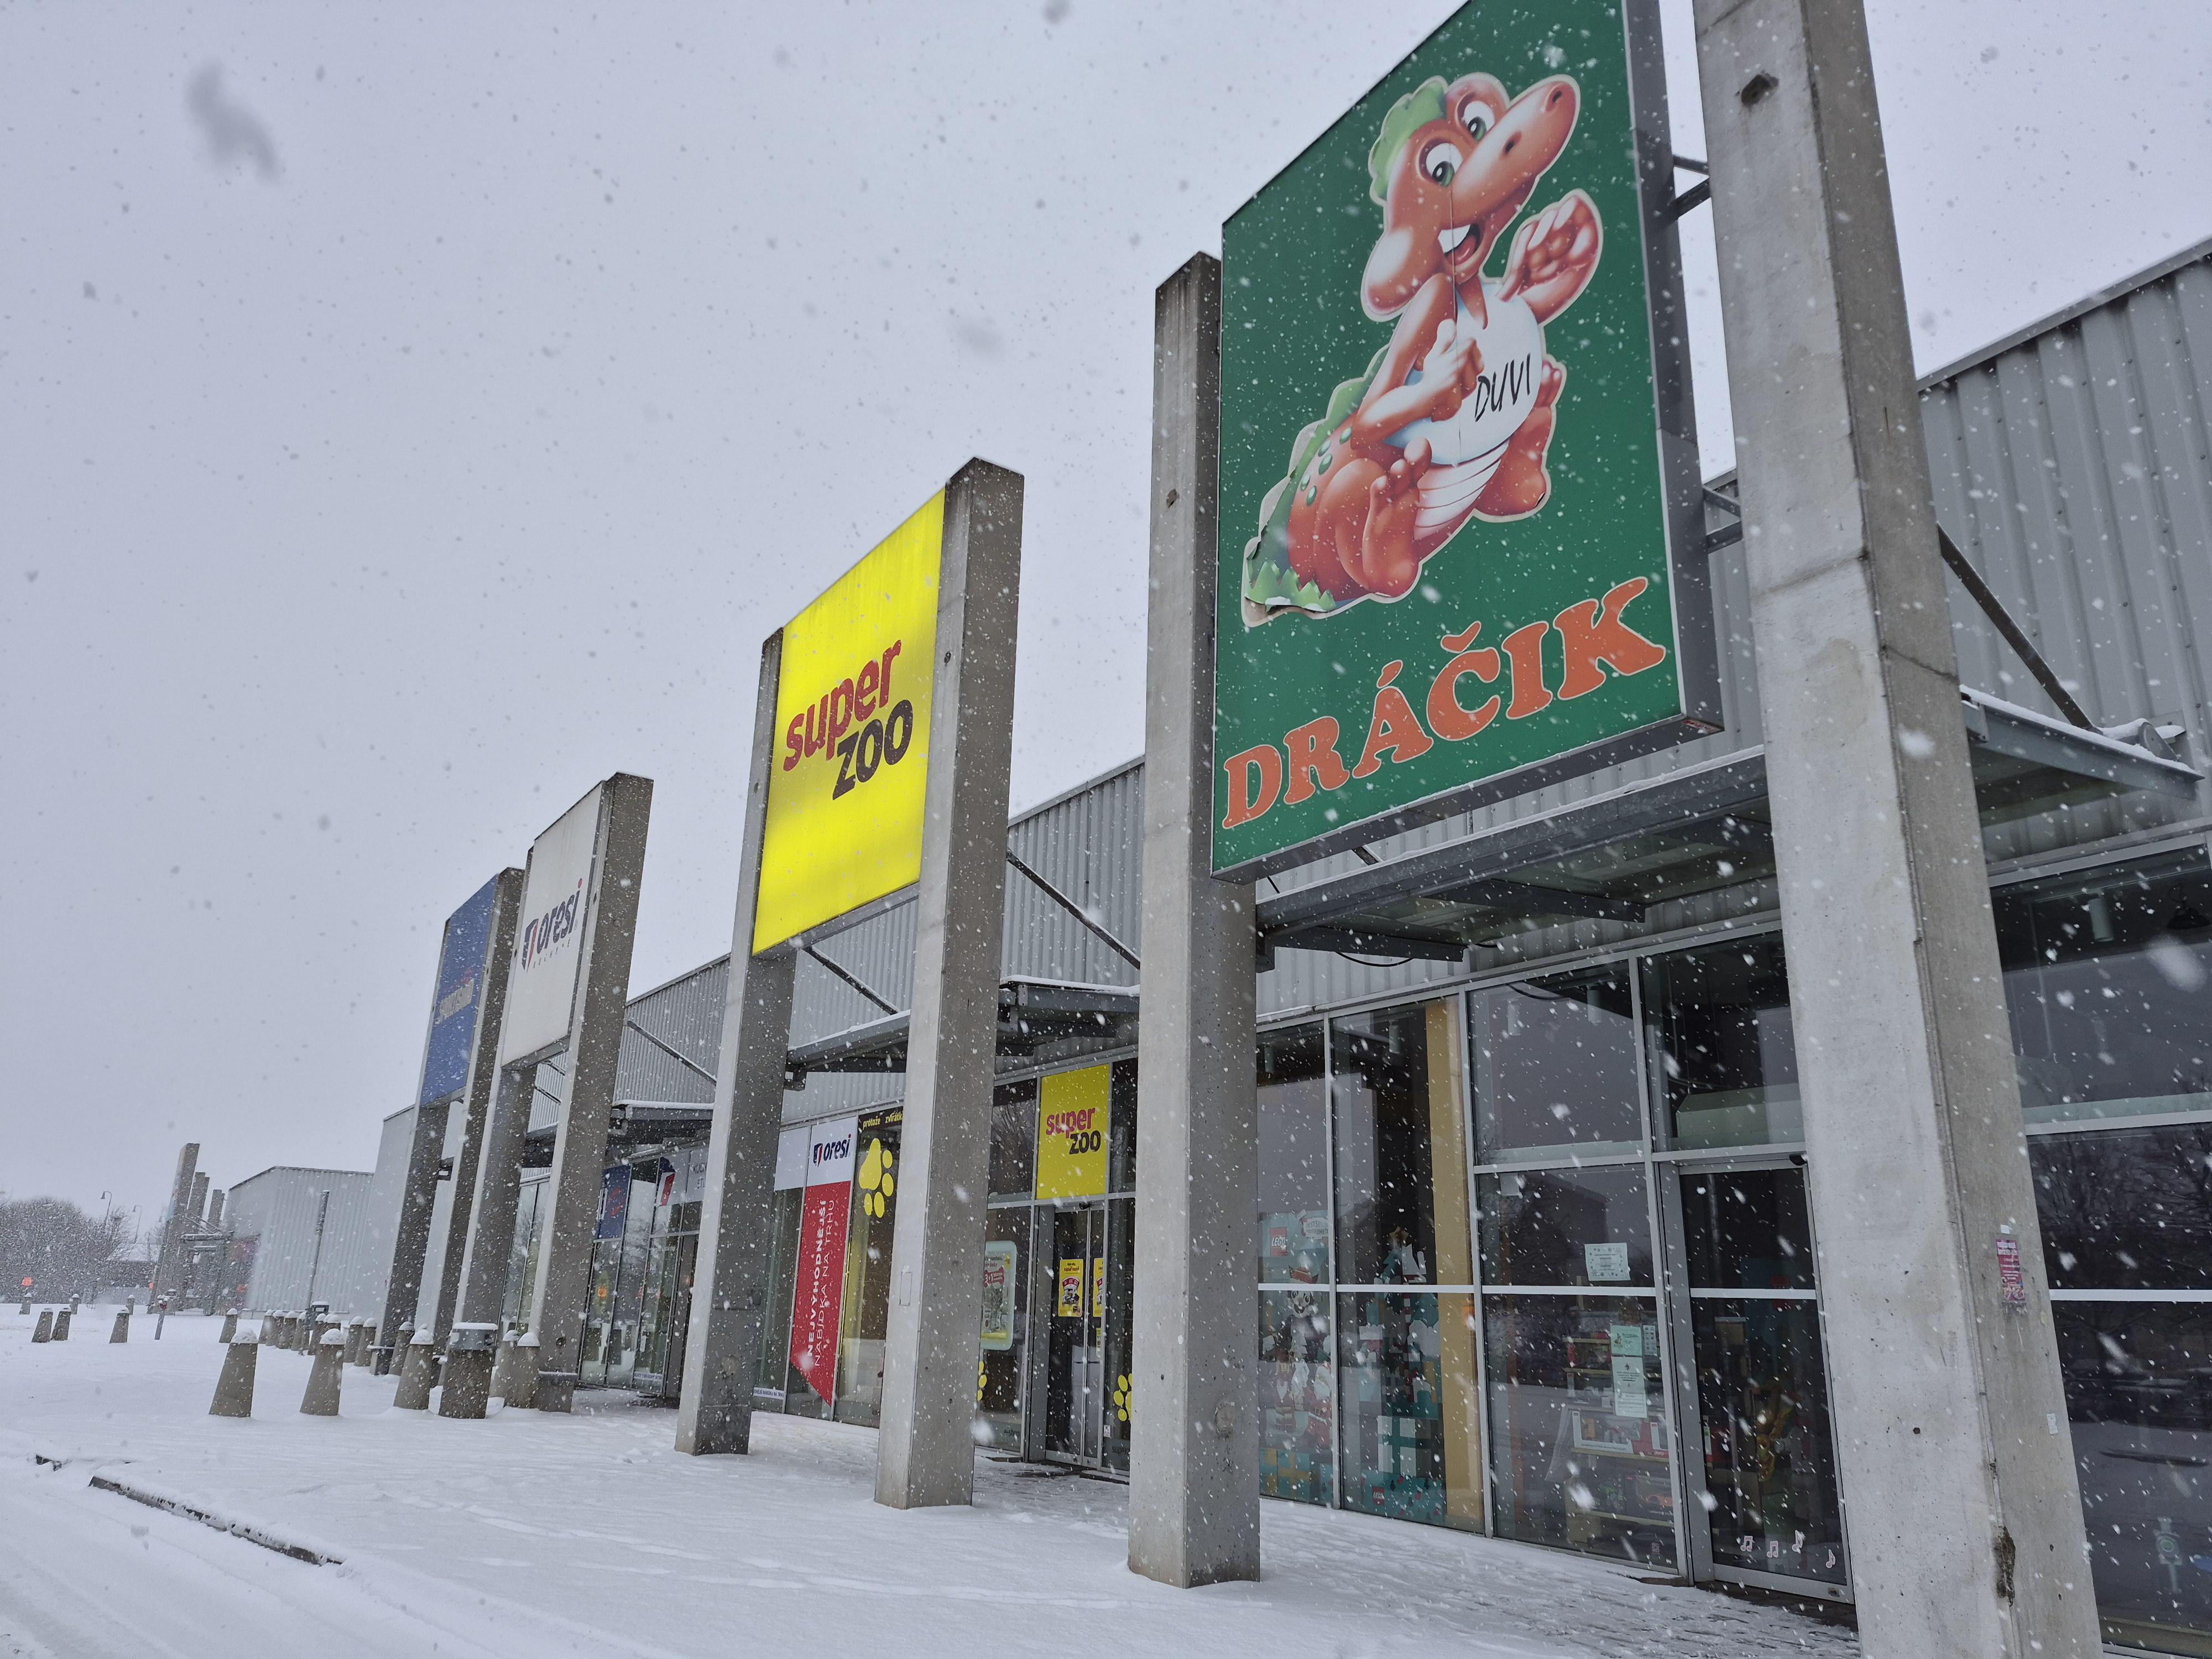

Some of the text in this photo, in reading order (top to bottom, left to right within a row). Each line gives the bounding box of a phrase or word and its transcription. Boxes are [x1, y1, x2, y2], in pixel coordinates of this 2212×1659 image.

[1474, 353, 1531, 422] DUVI
[783, 639, 902, 771] super
[1222, 576, 1666, 830] DRÁČIK
[536, 878, 583, 954] oresi
[823, 1134, 852, 1161] oresi
[1045, 1107, 1095, 1139] super
[807, 1199, 827, 1357] NEJVÝHODNĚJŠÍ
[1272, 1235, 1286, 1247] LEGO
[815, 1199, 834, 1367] NABÍDKA NA TRHU
